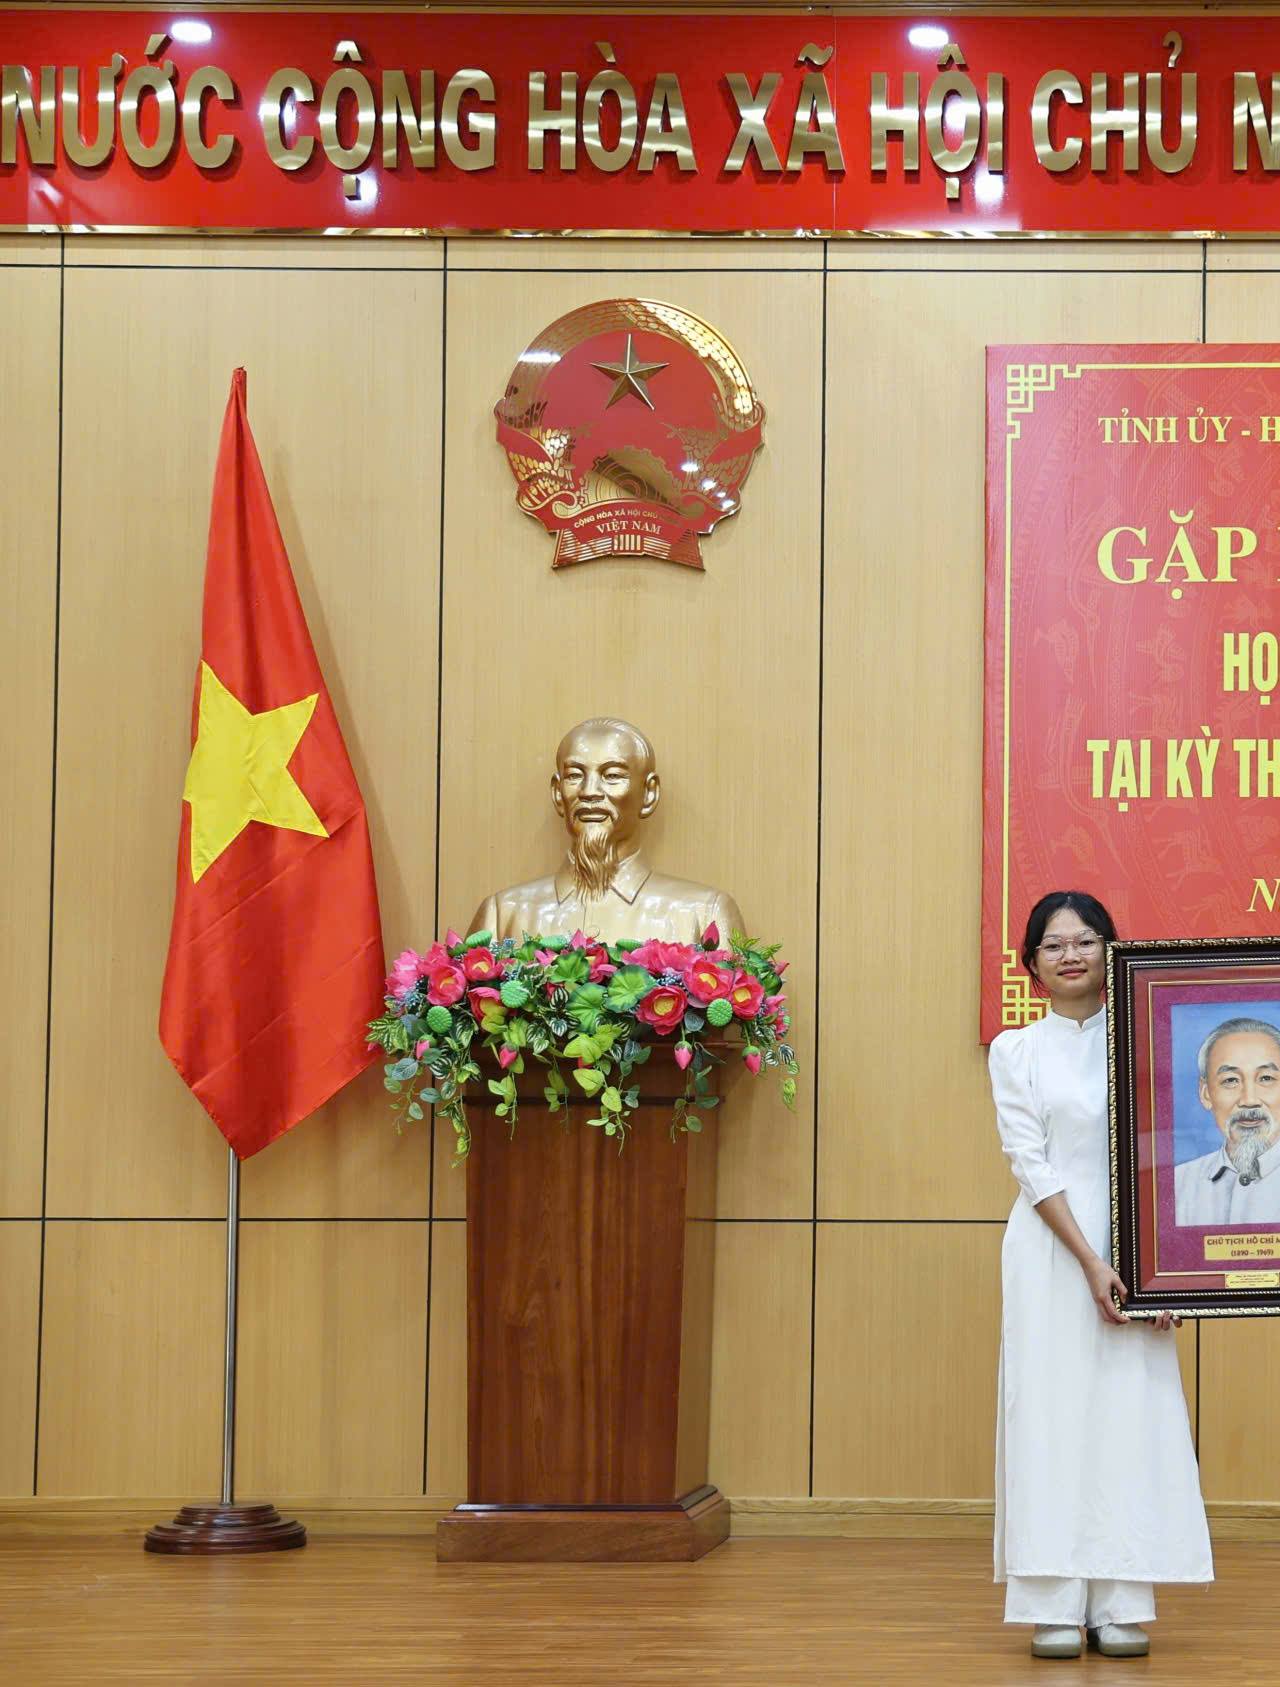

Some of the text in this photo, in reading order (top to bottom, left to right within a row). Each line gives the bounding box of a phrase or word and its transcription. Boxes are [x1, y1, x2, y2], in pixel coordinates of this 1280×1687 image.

[2, 34, 235, 168] NƯỚC
[261, 40, 497, 200] CỘNG
[528, 42, 699, 172] HÒA
[724, 44, 845, 172] XÃ
[870, 44, 1004, 199] HỘI
[1031, 31, 1198, 174] CHỦ
[1097, 407, 1179, 443] TỈNH
[1187, 406, 1232, 443] ỦY
[595, 518, 629, 534] VIỆT
[631, 520, 662, 535] NAM
[1096, 509, 1258, 600] GẶP
[1086, 738, 1151, 812] TẠI
[1166, 725, 1220, 798] KỲ
